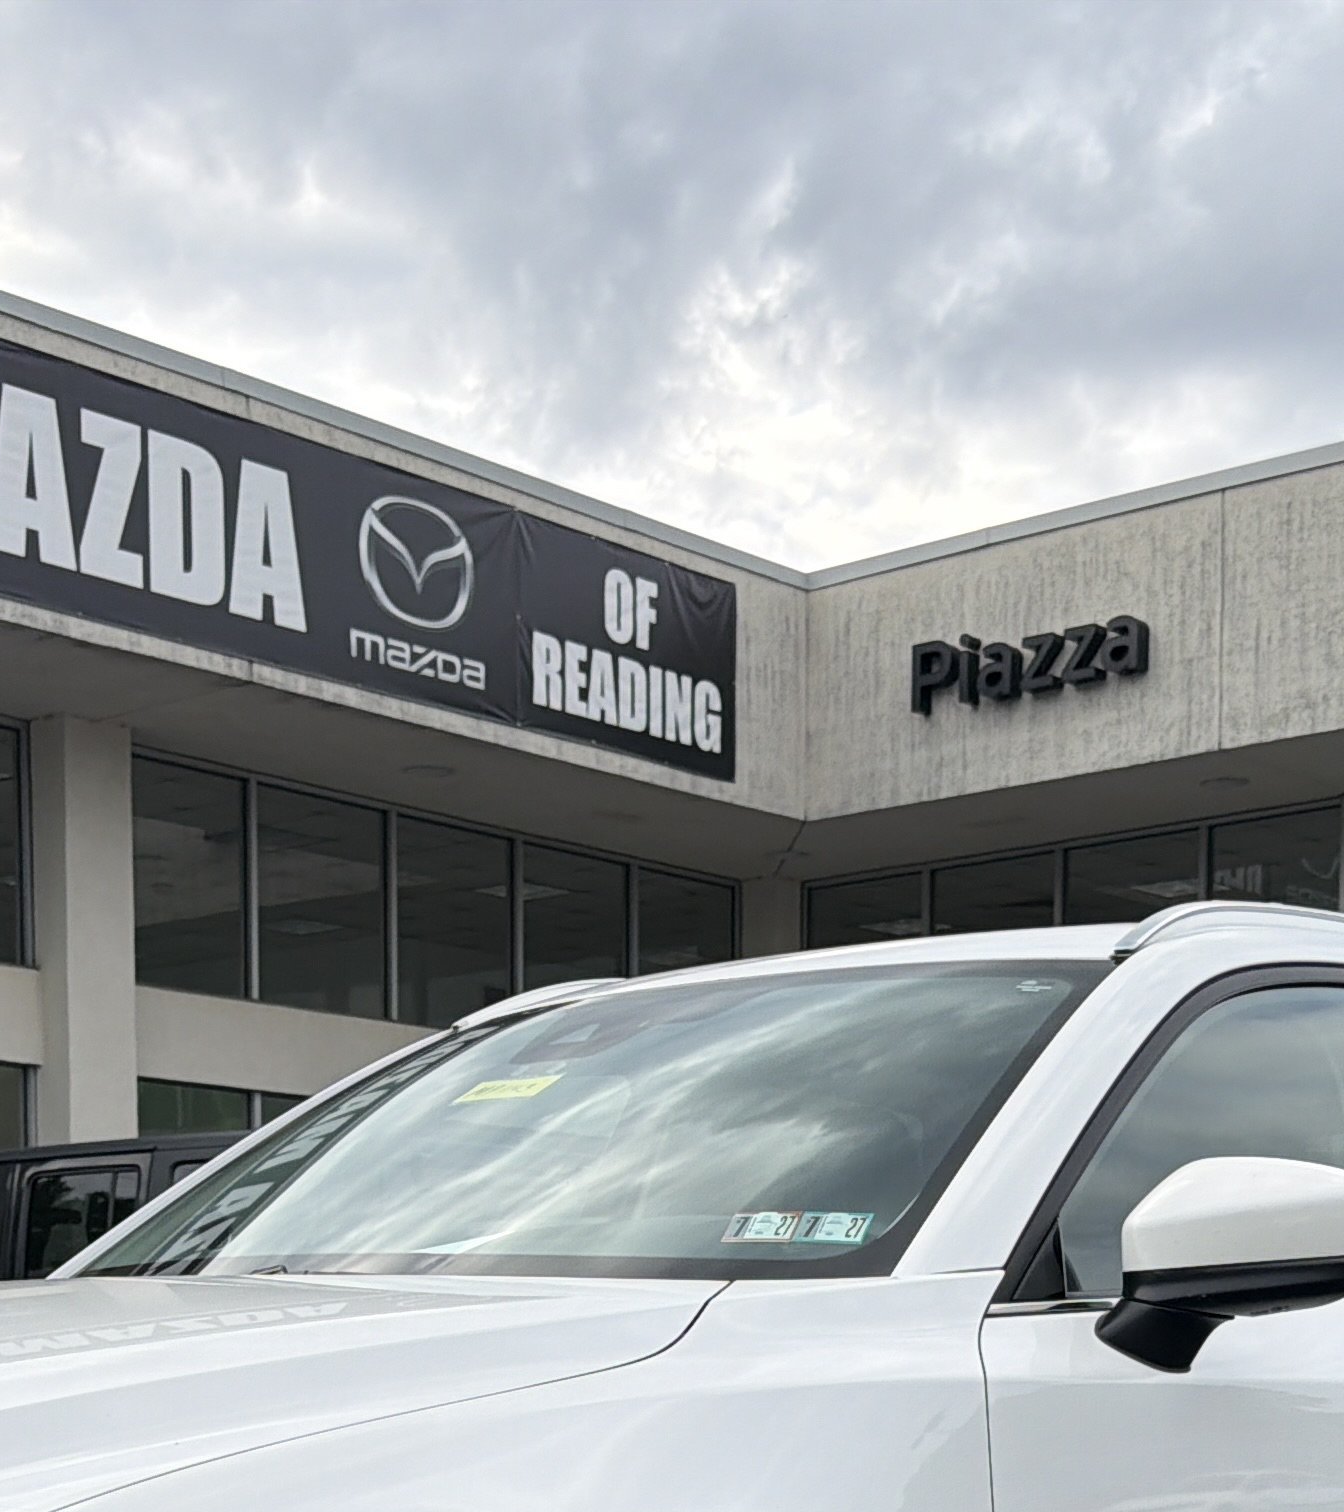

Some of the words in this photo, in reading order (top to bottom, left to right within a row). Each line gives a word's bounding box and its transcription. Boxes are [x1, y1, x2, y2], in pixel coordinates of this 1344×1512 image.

[603, 567, 659, 652] OF
[349, 627, 487, 691] mazda
[531, 630, 723, 755] READING
[911, 614, 1150, 716] Piazza
